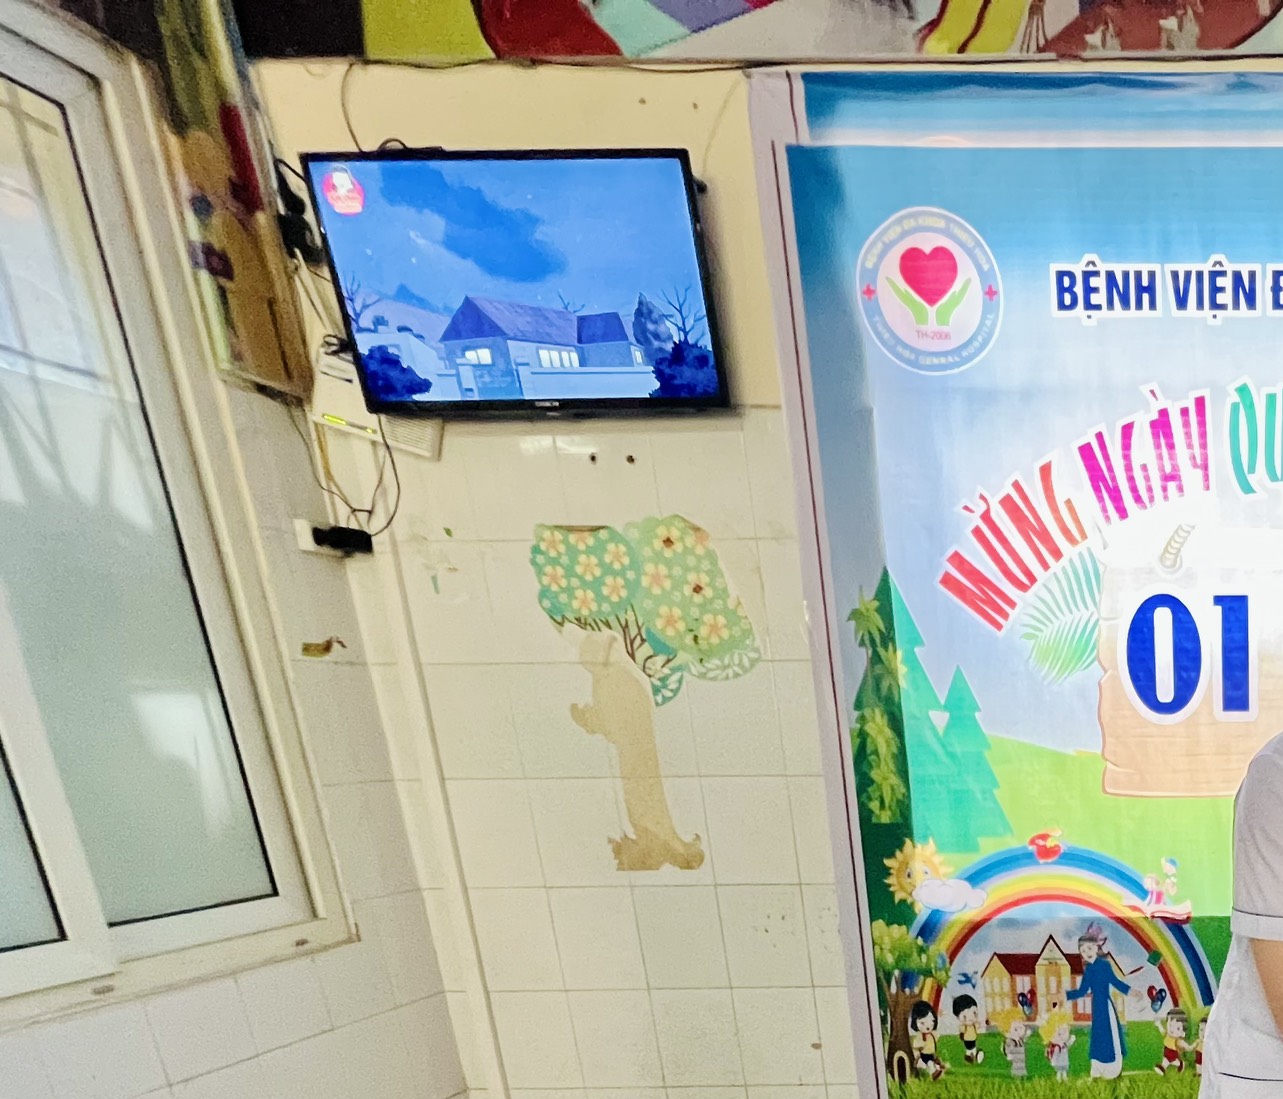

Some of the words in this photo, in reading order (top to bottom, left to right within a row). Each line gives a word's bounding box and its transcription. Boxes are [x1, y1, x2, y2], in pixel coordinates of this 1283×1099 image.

[1054, 260, 1158, 319] BỆNH
[1169, 260, 1258, 319] VIỆN
[938, 460, 1088, 632] MỪNG
[1077, 388, 1211, 526] NGÀY
[1126, 593, 1250, 716] 01
